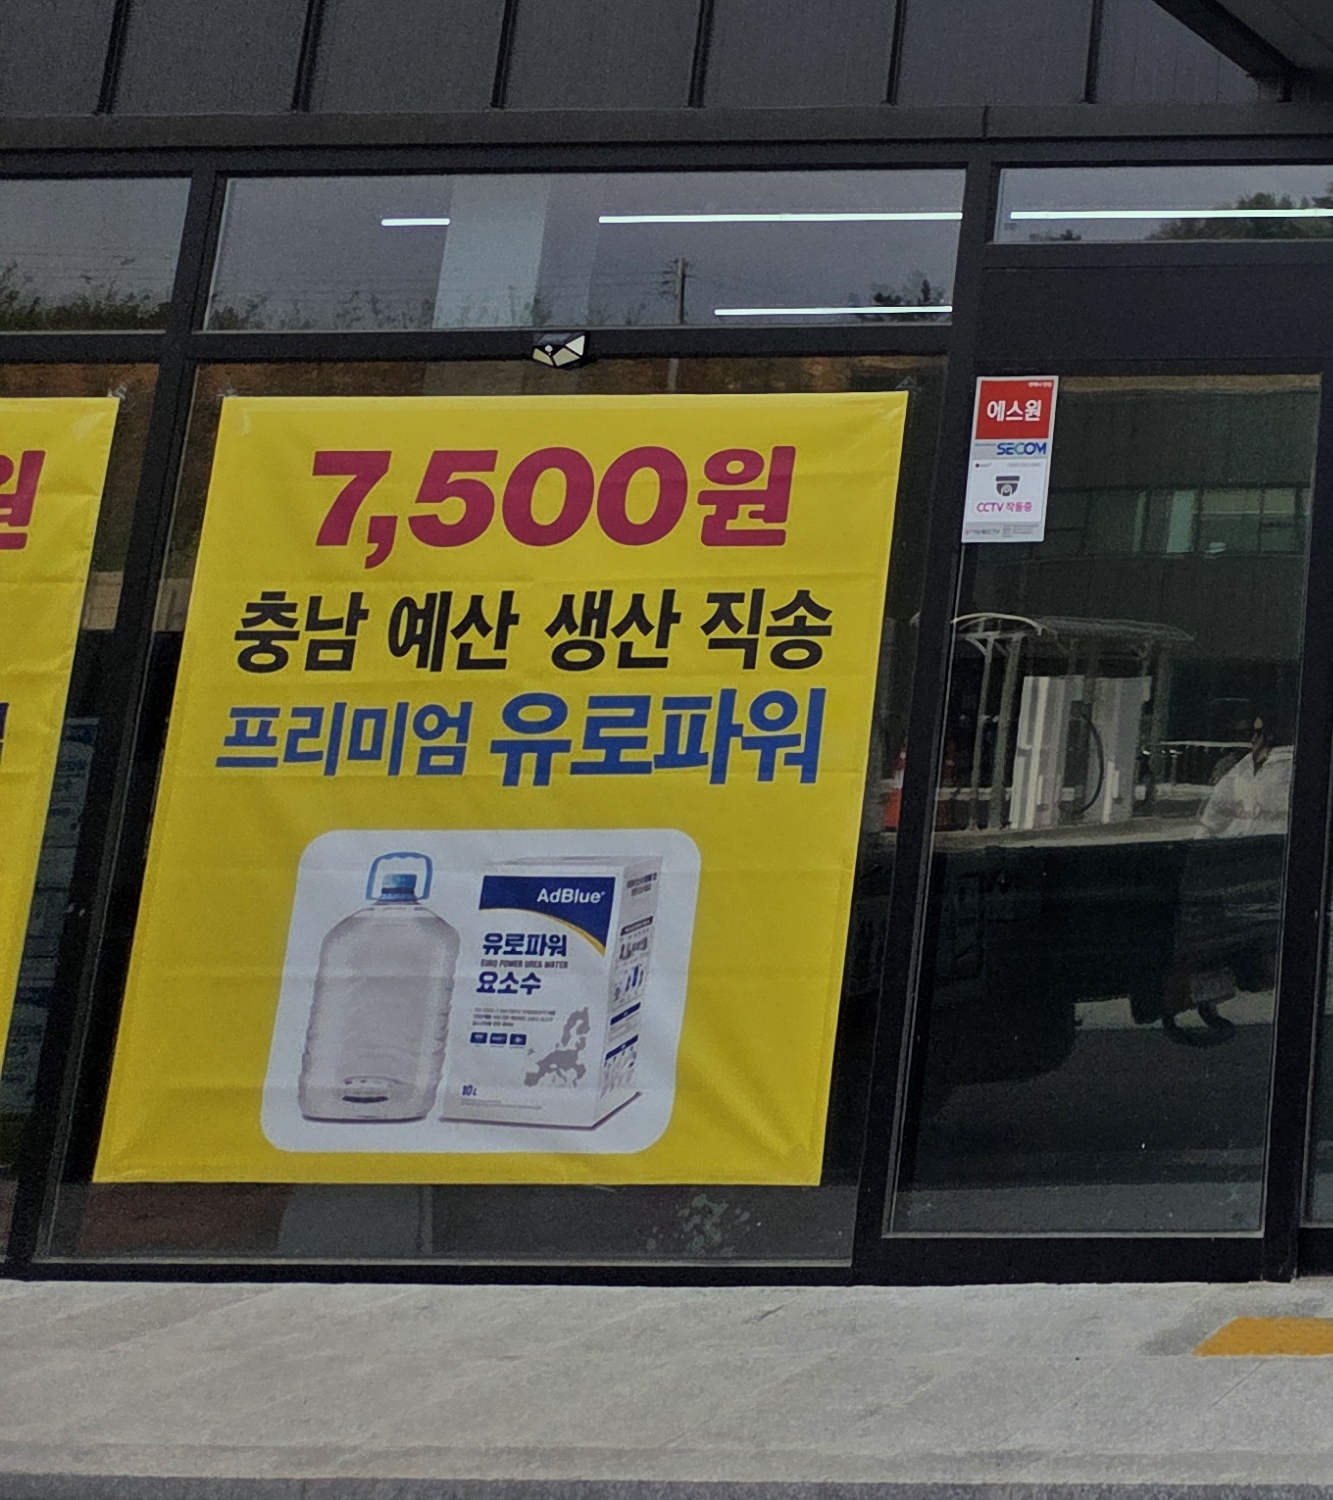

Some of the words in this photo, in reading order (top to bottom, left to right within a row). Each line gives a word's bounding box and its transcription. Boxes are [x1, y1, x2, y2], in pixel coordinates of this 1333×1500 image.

[986, 400, 1042, 422] 에스원
[996, 442, 1047, 455] SECOM
[311, 445, 797, 570] 7,500원
[976, 501, 1004, 512] CCTV
[234, 590, 370, 674] 충남
[387, 590, 520, 673] 예산
[544, 588, 682, 672] 생산
[700, 588, 833, 670] 직송
[215, 700, 474, 777] 프리미엄
[489, 687, 827, 788] 유로파워
[537, 887, 602, 904] AdBlue
[482, 932, 568, 958] 유로파워
[475, 971, 542, 996] 요소수
